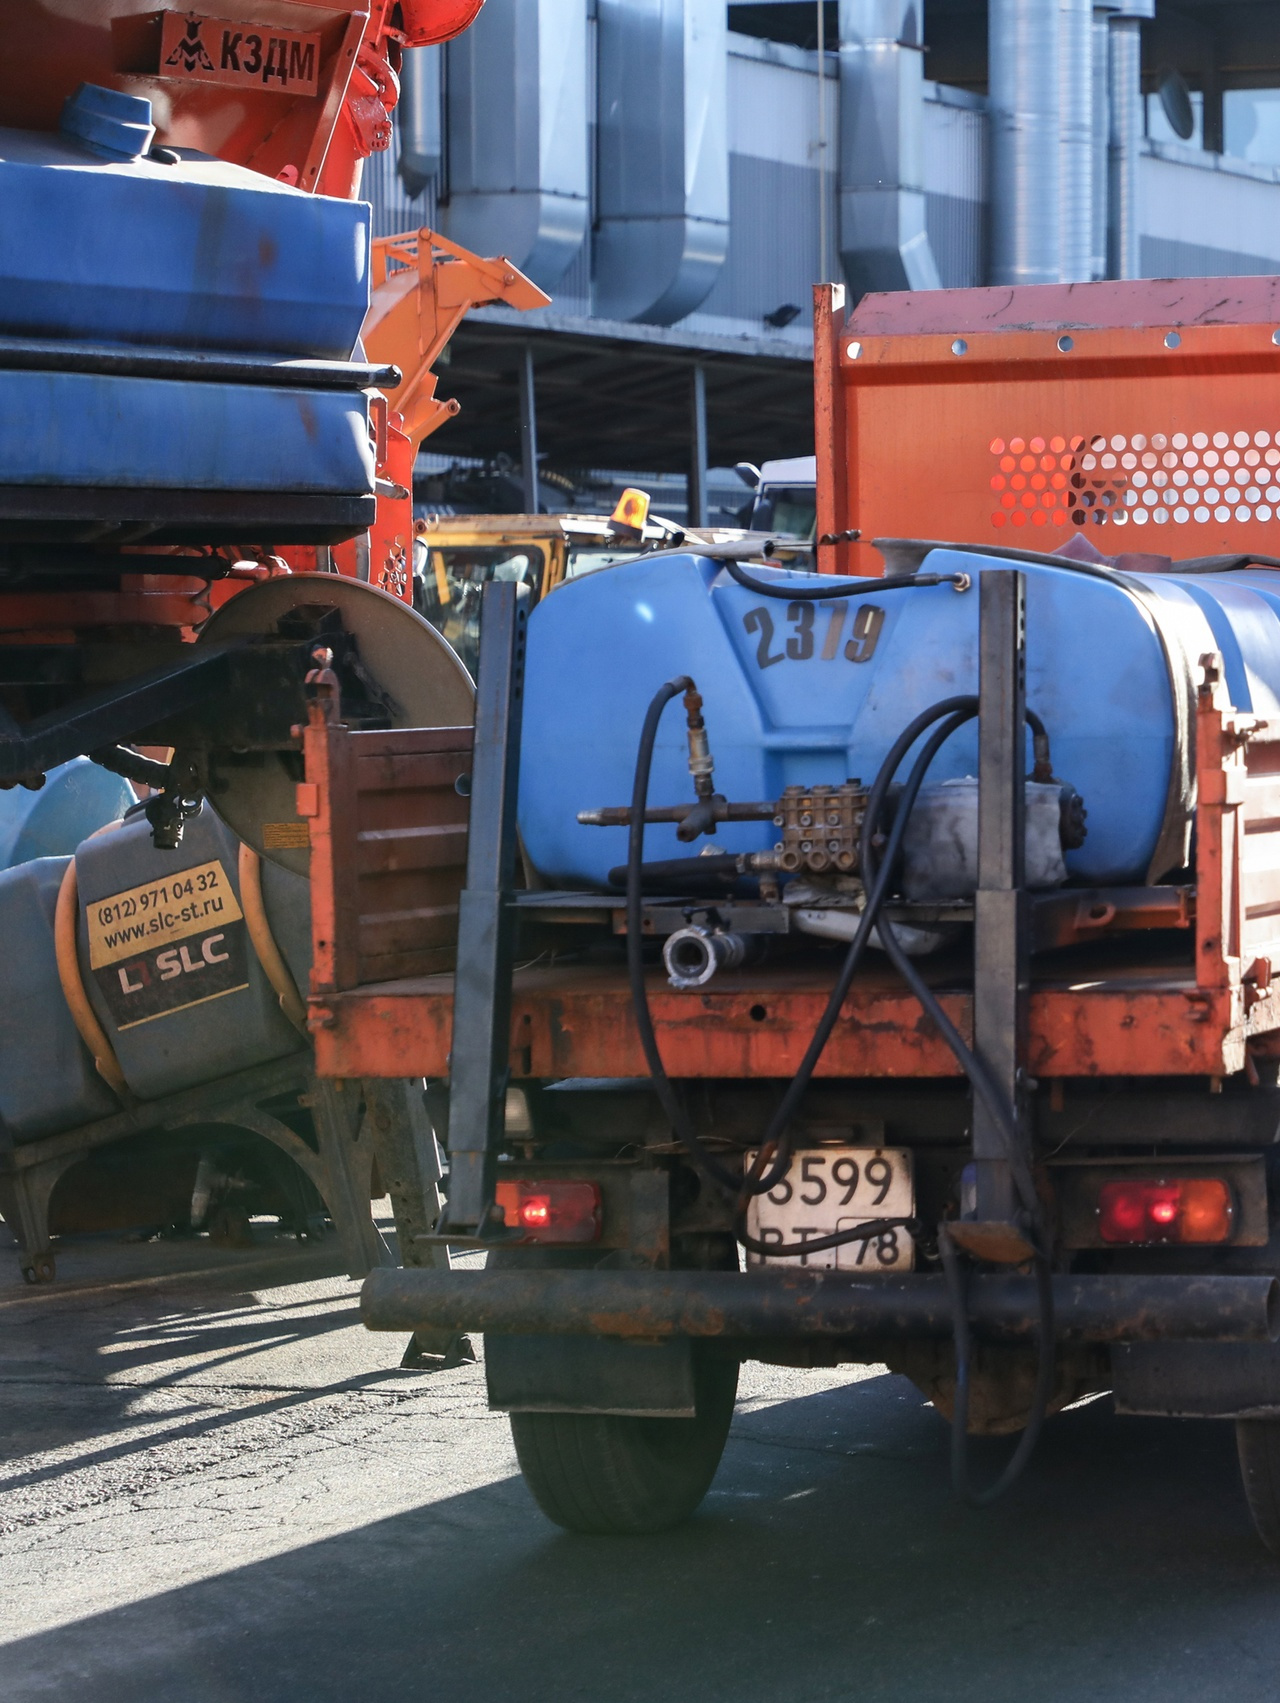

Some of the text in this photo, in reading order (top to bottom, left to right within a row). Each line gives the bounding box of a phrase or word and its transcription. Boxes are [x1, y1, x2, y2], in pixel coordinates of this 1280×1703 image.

[221, 30, 315, 86] КЗДМ
[742, 600, 886, 670] 2379
[98, 870, 219, 927] (812) 971 04 32
[104, 896, 224, 949] www.slc-st.ru
[156, 933, 230, 981] SLC
